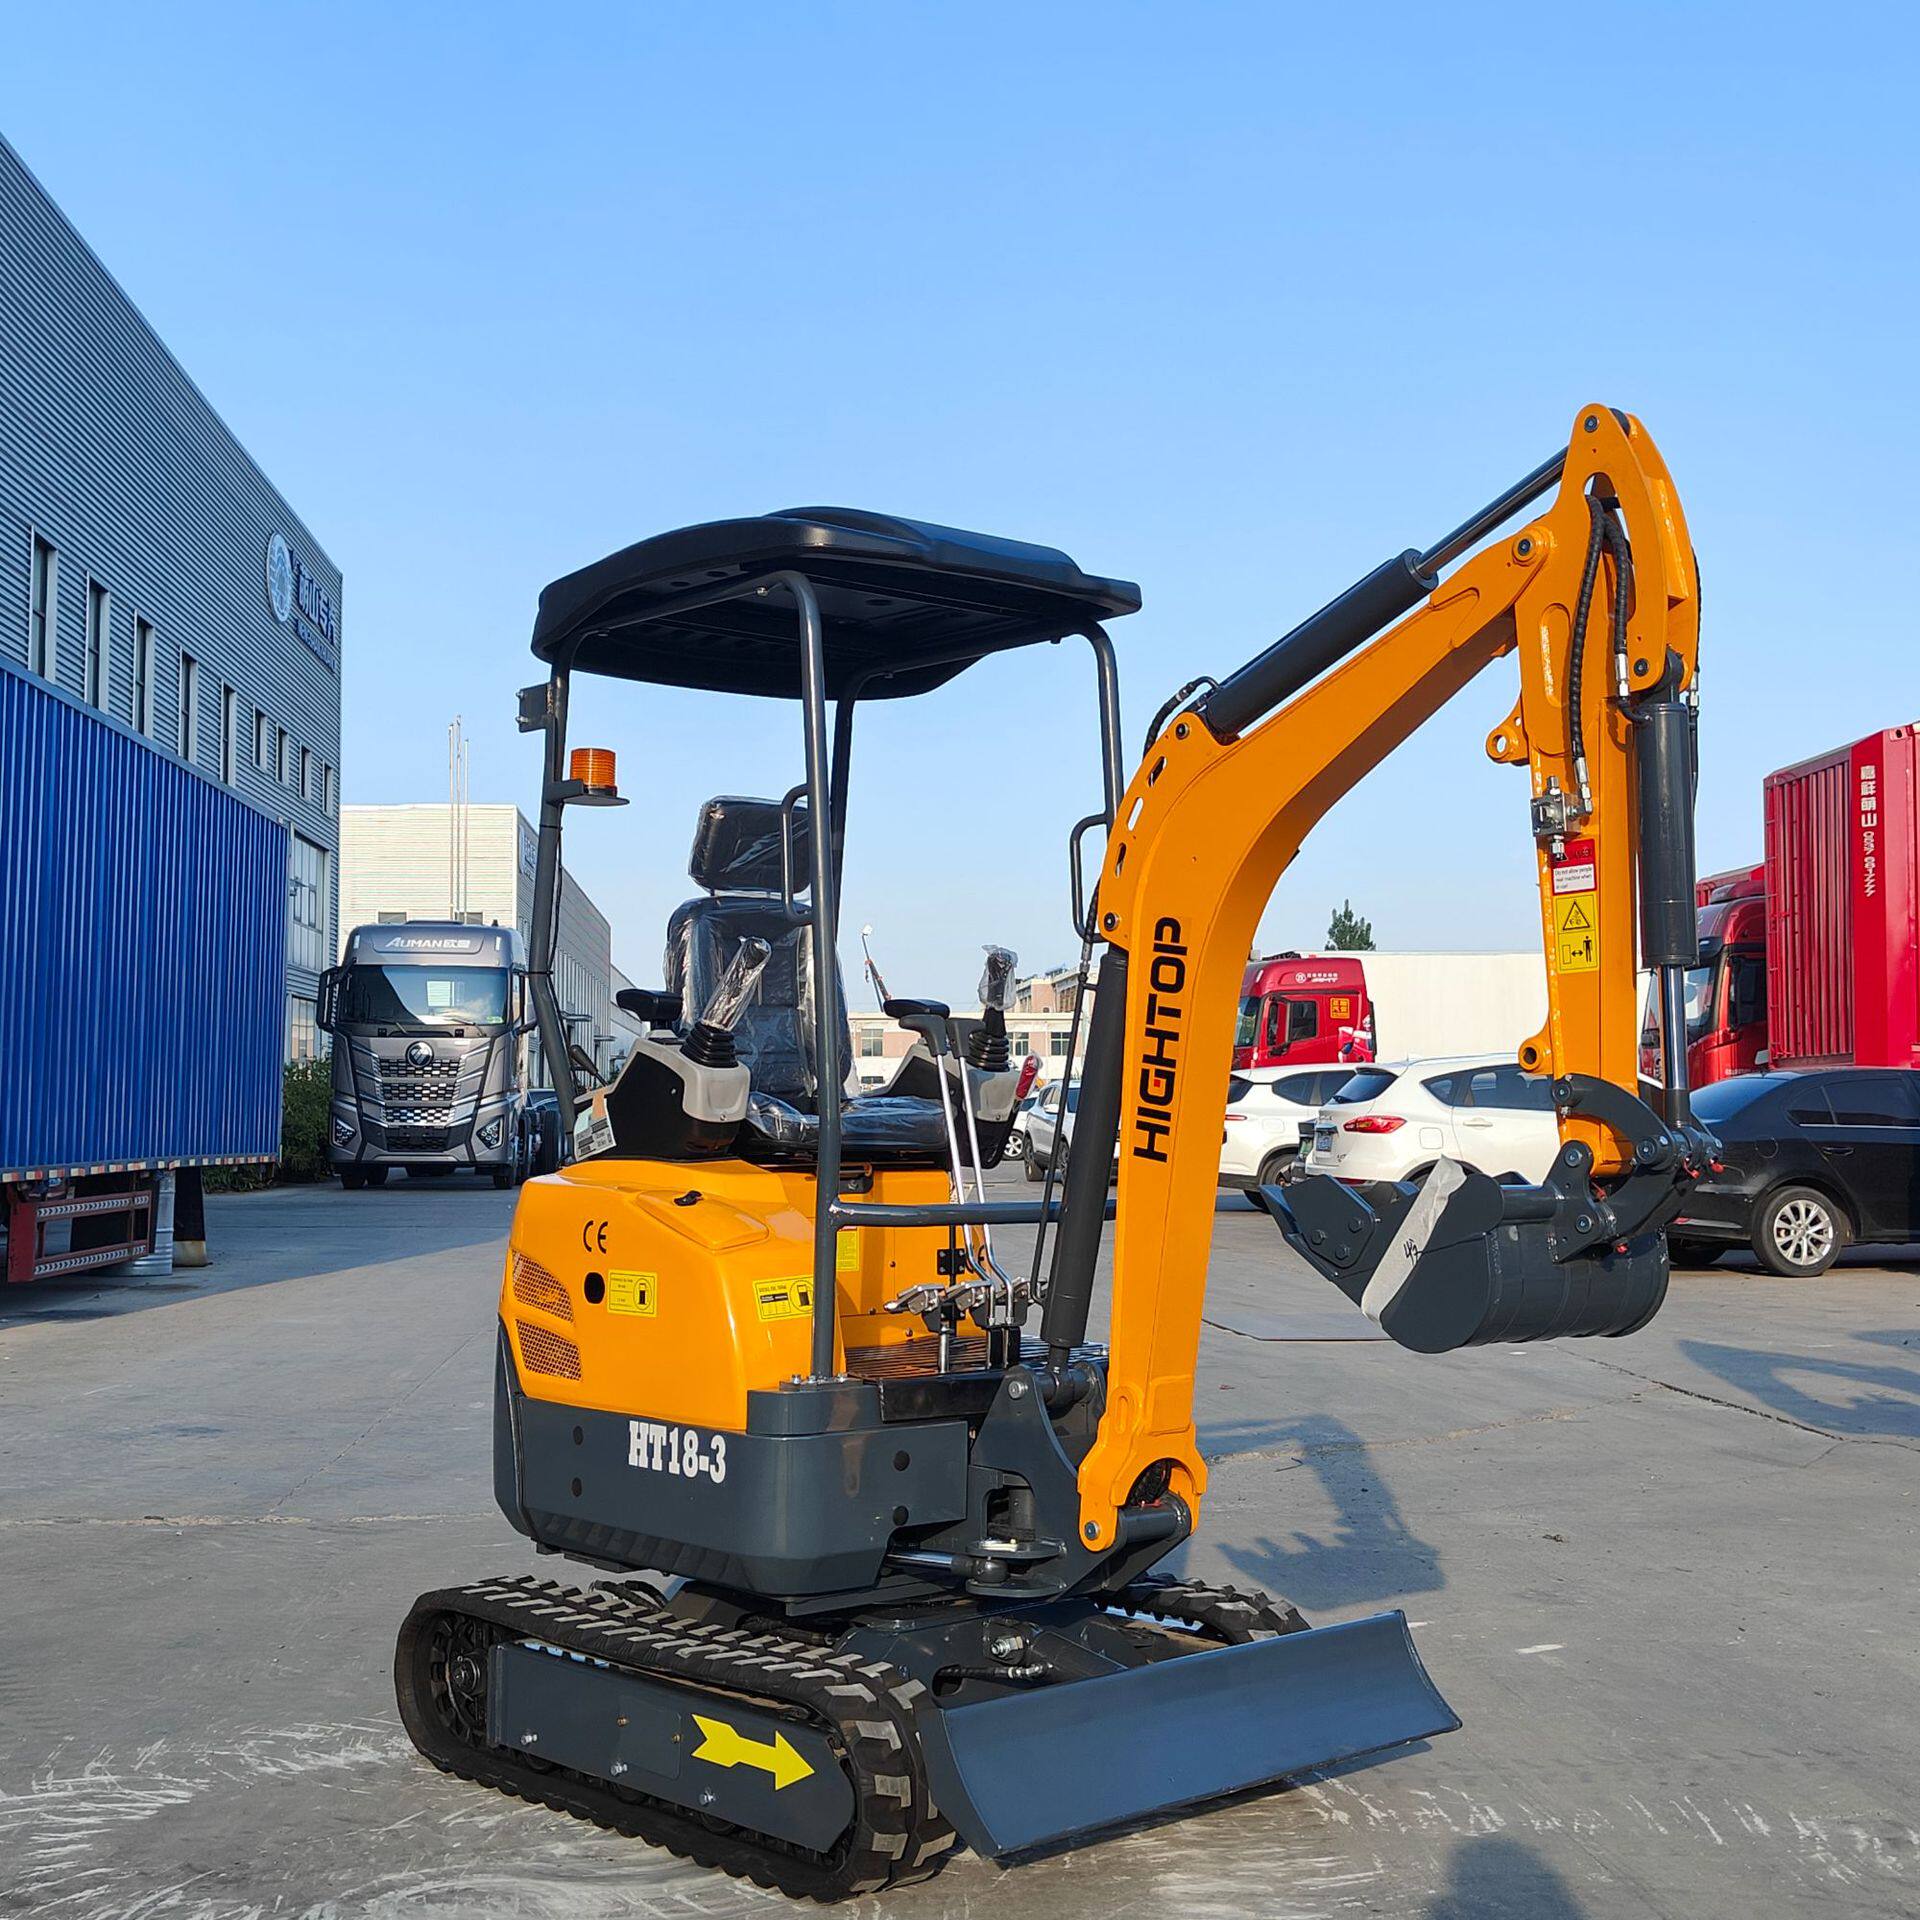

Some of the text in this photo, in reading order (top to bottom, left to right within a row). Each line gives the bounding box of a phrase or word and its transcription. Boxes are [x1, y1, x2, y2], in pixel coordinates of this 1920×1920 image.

[385, 937, 442, 948] AUMAN
[1133, 916, 1188, 1163] HIGHTOP
[583, 1220, 608, 1254] CE
[628, 1420, 726, 1484] HT18-3
